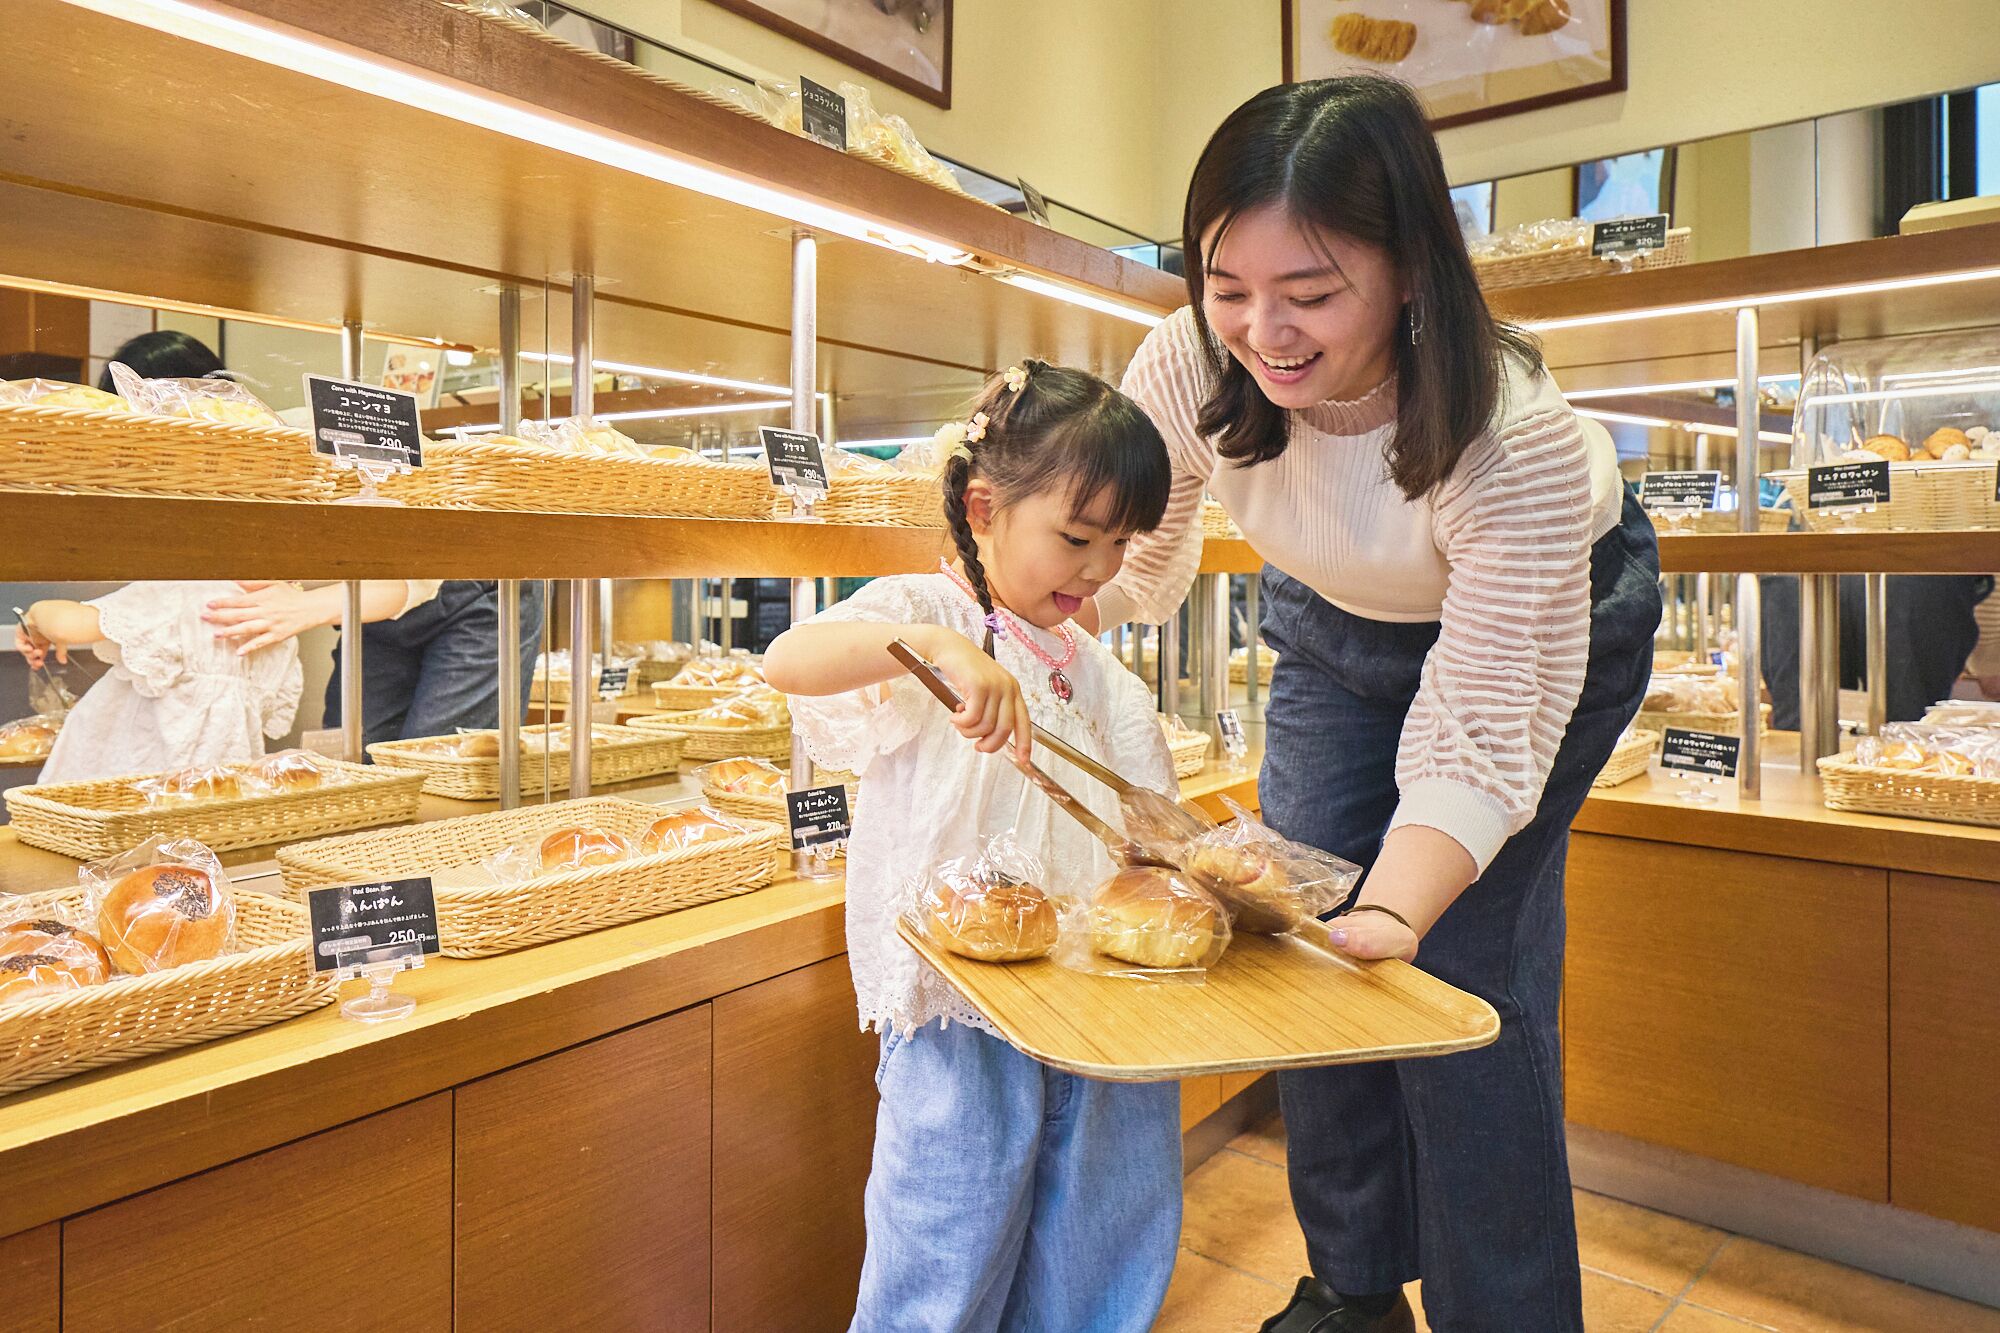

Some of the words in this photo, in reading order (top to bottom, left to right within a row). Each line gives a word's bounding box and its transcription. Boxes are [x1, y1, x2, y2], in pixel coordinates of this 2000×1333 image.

[331, 384, 344, 393] Corn
[340, 397, 391, 414] コーンマヨ
[782, 442, 806, 453] ツナマヨ
[1817, 469, 1879, 482] ミニクロワッサン
[1854, 487, 1874, 498] 120
[797, 794, 839, 813] クリームパン
[365, 886, 380, 894] Bean
[381, 884, 393, 892] Bun
[345, 895, 404, 914] あんぱん
